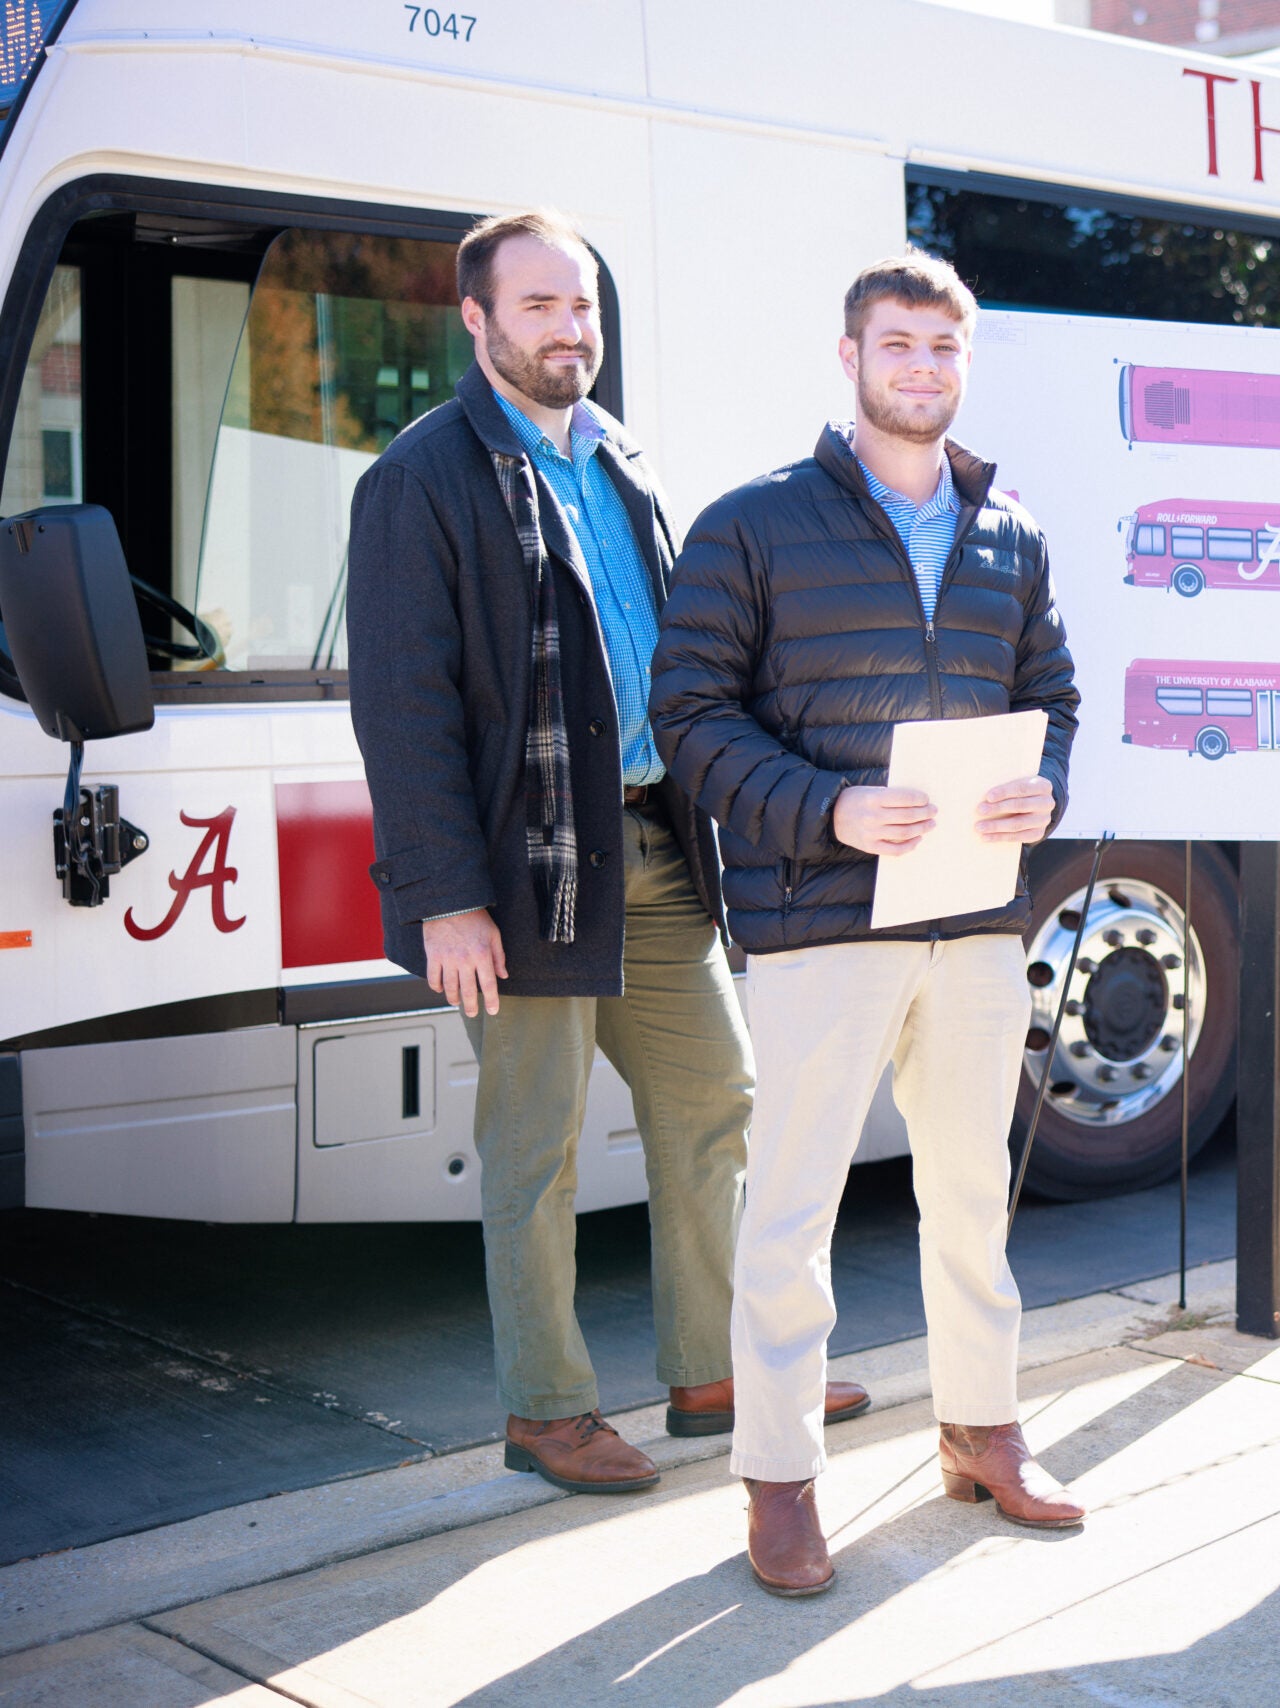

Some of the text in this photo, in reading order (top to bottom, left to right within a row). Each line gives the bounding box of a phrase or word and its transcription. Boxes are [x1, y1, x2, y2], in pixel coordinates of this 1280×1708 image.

[404, 4, 477, 42] 7047
[1157, 512, 1218, 525] ROLL FORWARD
[1156, 675, 1172, 685] THE
[1173, 676, 1219, 686] UNIVERSITY
[1220, 677, 1232, 687] OF
